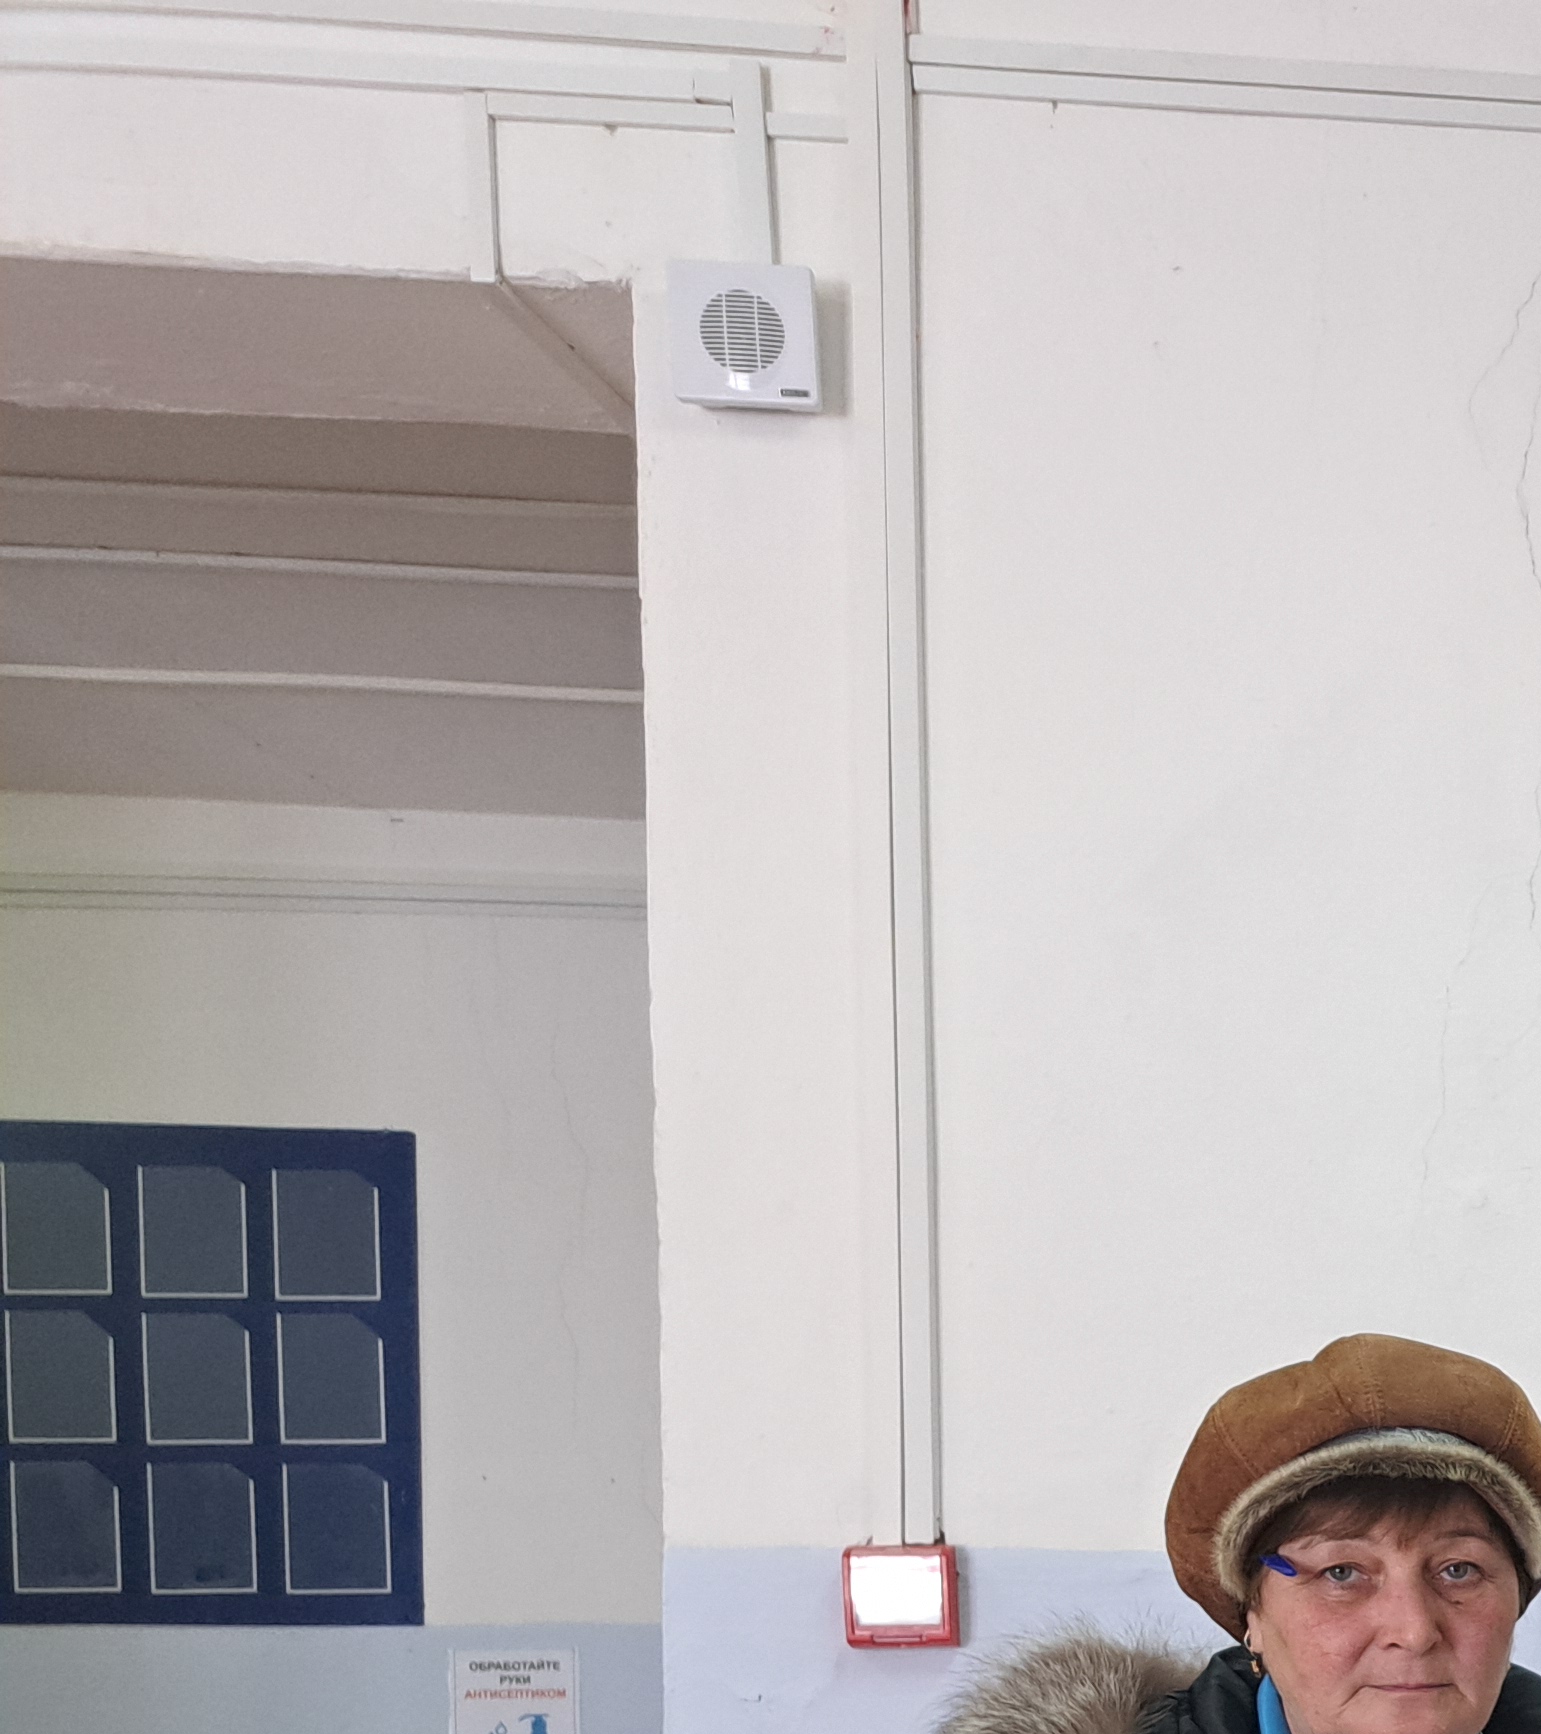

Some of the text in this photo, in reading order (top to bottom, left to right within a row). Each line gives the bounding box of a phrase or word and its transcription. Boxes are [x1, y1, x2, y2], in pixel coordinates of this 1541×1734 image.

[468, 1659, 561, 1672] ОБРАБОТАЙТЕ
[499, 1675, 531, 1685] РУКИ
[464, 1688, 567, 1699] АНТИСЕПТИКОМ
